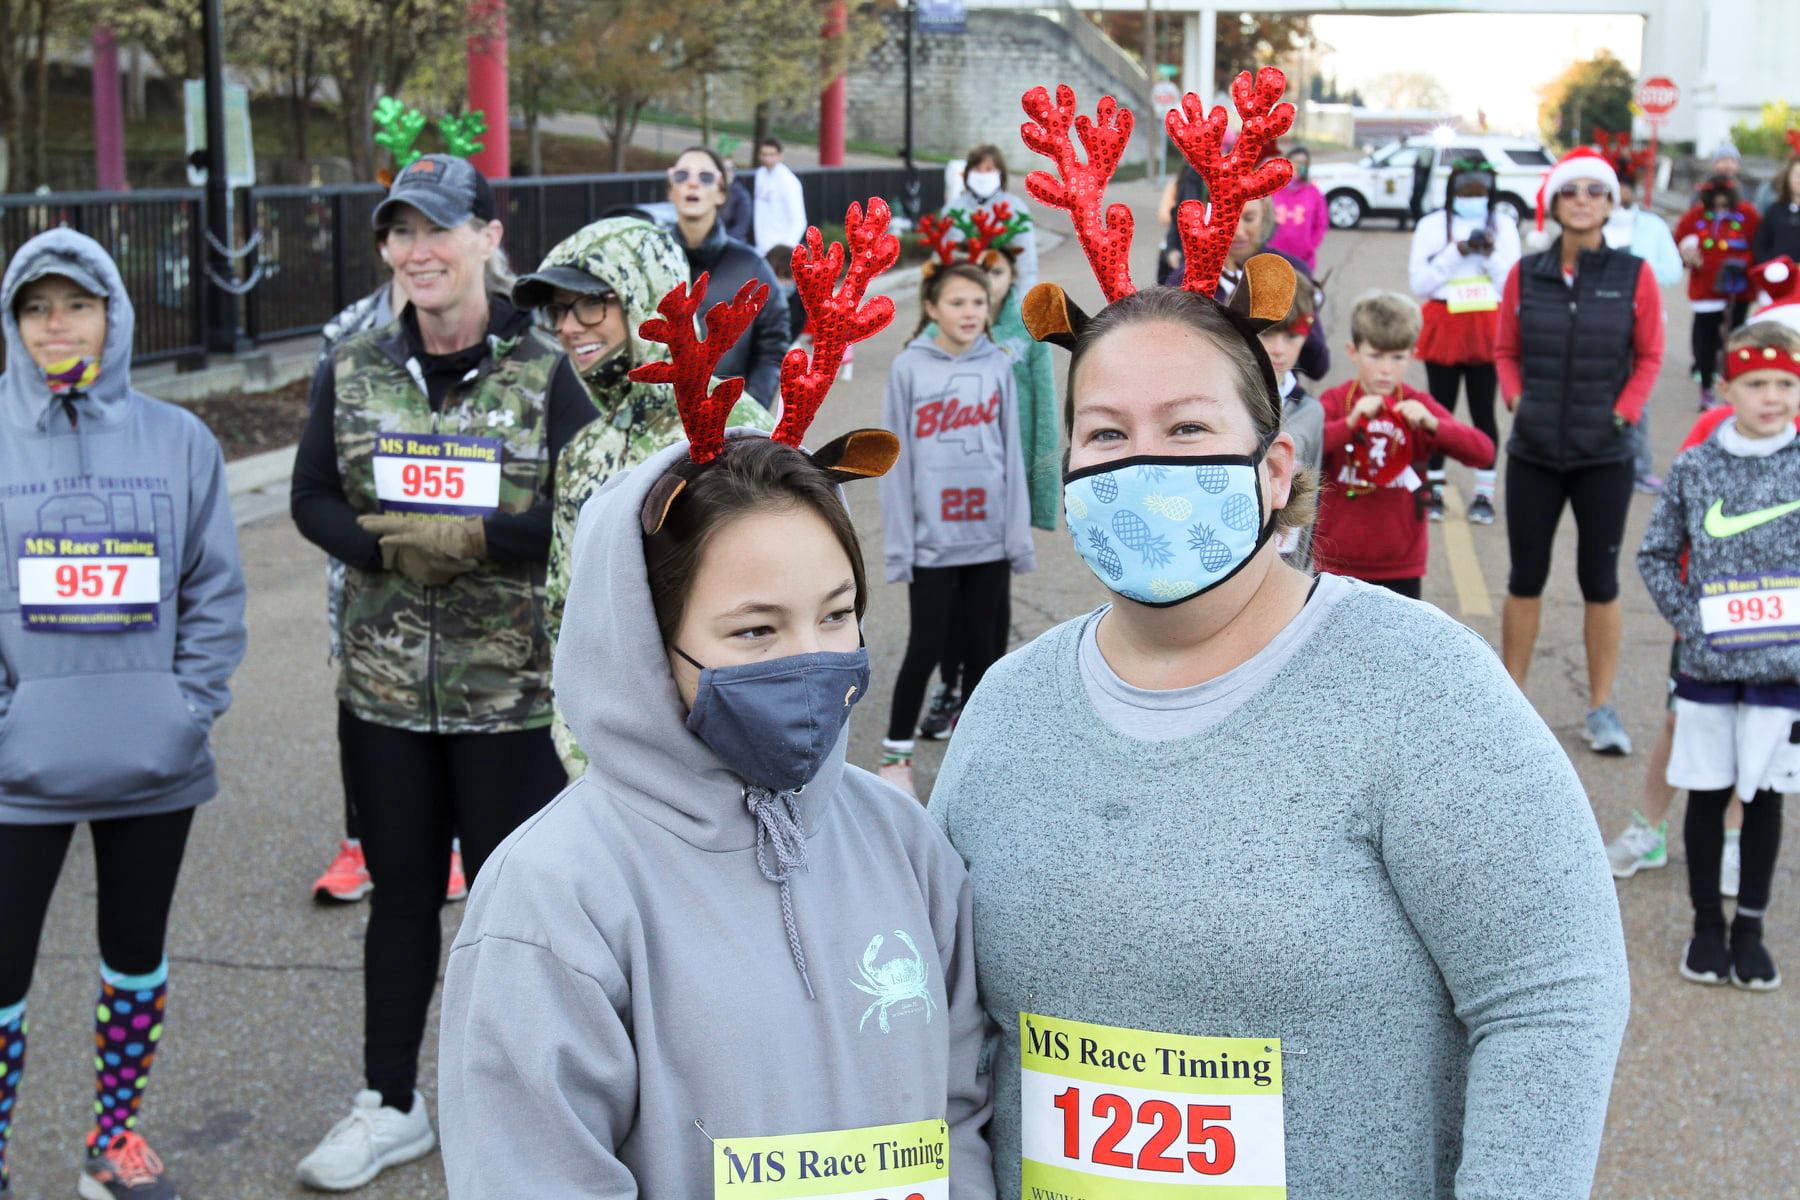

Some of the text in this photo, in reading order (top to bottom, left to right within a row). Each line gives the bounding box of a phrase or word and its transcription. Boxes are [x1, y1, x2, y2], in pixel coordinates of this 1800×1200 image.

[1640, 86, 1679, 106] STOP
[915, 391, 998, 439] Blast
[380, 438, 496, 461] MS Race Timing
[98, 477, 168, 490] UNIVERSITY
[402, 464, 464, 498] 955
[941, 487, 987, 521] 22
[25, 538, 154, 557] MS Race Timing
[55, 564, 128, 598] 957
[1727, 595, 1783, 623] 993
[1027, 1027, 1272, 1087] MS Race Timing
[1054, 1086, 1236, 1176] 1225
[726, 1137, 945, 1185] MS Race Timing
